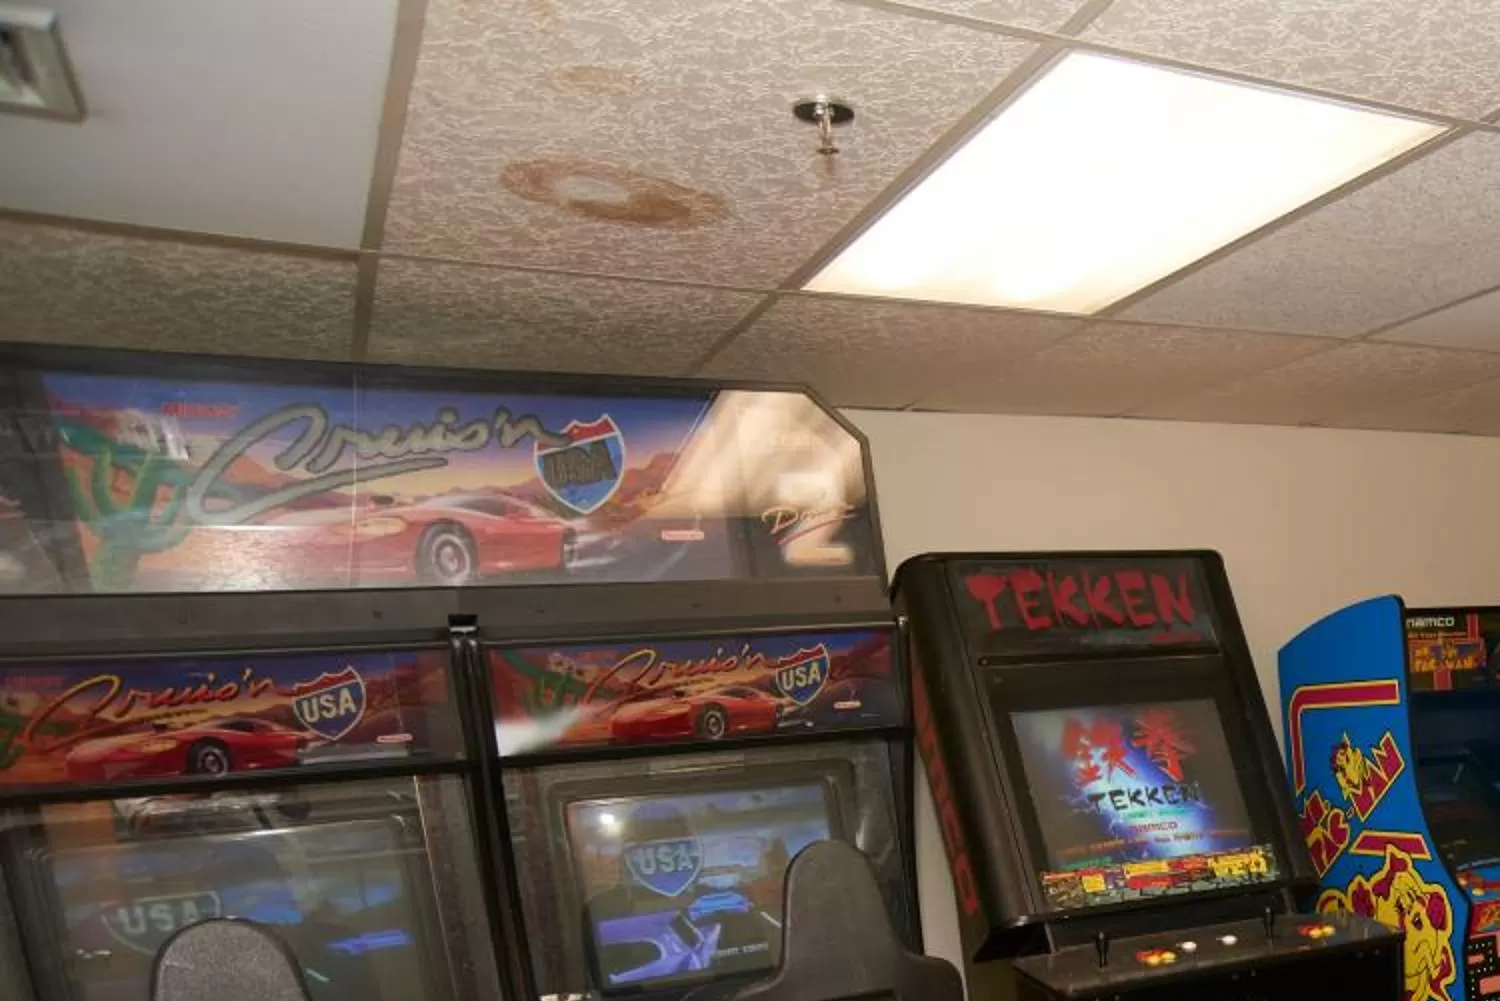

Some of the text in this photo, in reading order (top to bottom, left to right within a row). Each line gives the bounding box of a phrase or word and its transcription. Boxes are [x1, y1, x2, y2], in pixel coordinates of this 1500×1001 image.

[966, 565, 1196, 633] TEKKEN
[1405, 615, 1455, 629] namco
[781, 662, 821, 692] USA
[302, 687, 357, 724] USA
[1087, 782, 1200, 814] TEKKEN
[641, 847, 694, 875] USA
[116, 900, 198, 935] USA
